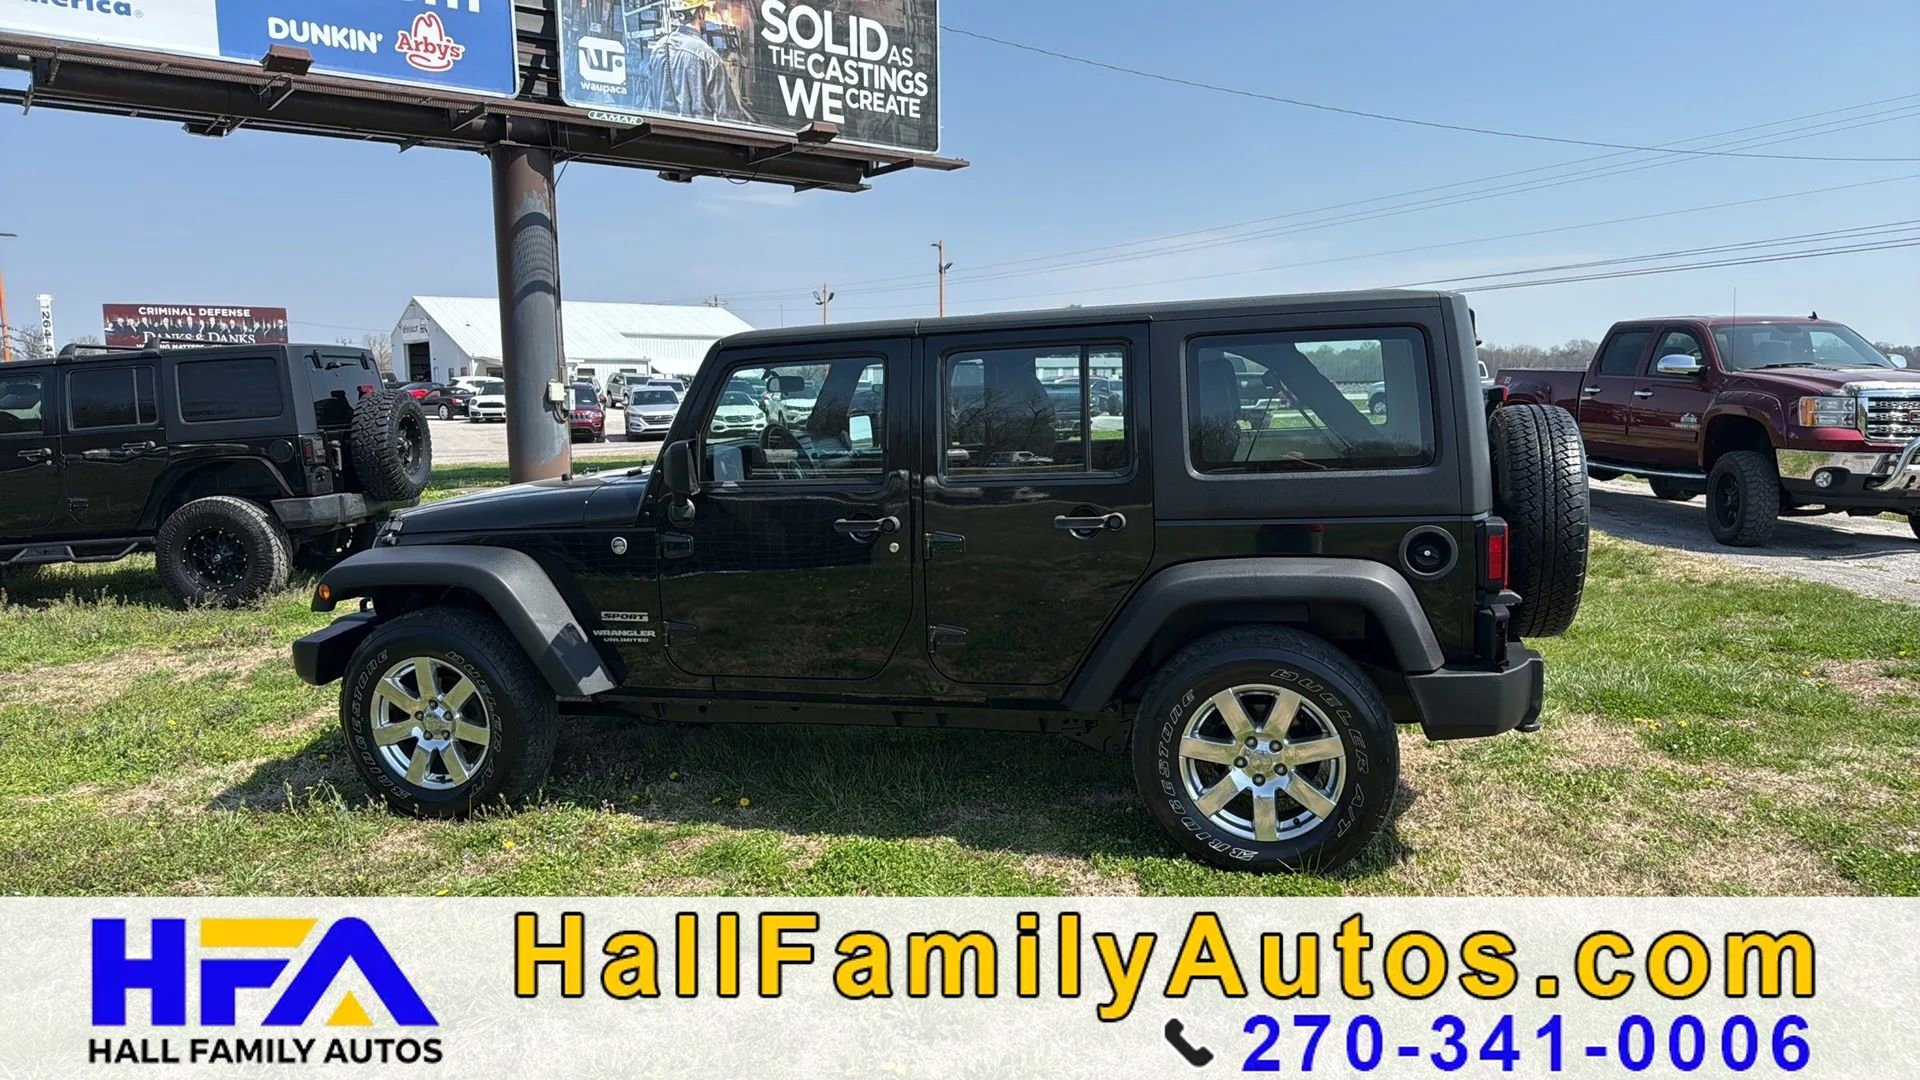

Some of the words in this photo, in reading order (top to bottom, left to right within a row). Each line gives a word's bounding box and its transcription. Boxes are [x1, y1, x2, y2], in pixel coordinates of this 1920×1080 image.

[267, 16, 383, 54] DUNKIN'
[397, 33, 462, 60] Arby's
[761, 0, 889, 61] SOLID
[887, 45, 914, 67] AS
[768, 45, 806, 70] THE
[806, 53, 929, 97] CASTINGS
[592, 111, 638, 124] LAMAR
[777, 75, 846, 124] WE
[845, 88, 921, 119] CREATE
[138, 306, 196, 316] CRIMINAL
[199, 308, 251, 317] DEFENSE
[602, 612, 647, 621] SPORT
[1270, 668, 1369, 774] DUELER
[1158, 688, 1258, 862] BRIDGESTONE
